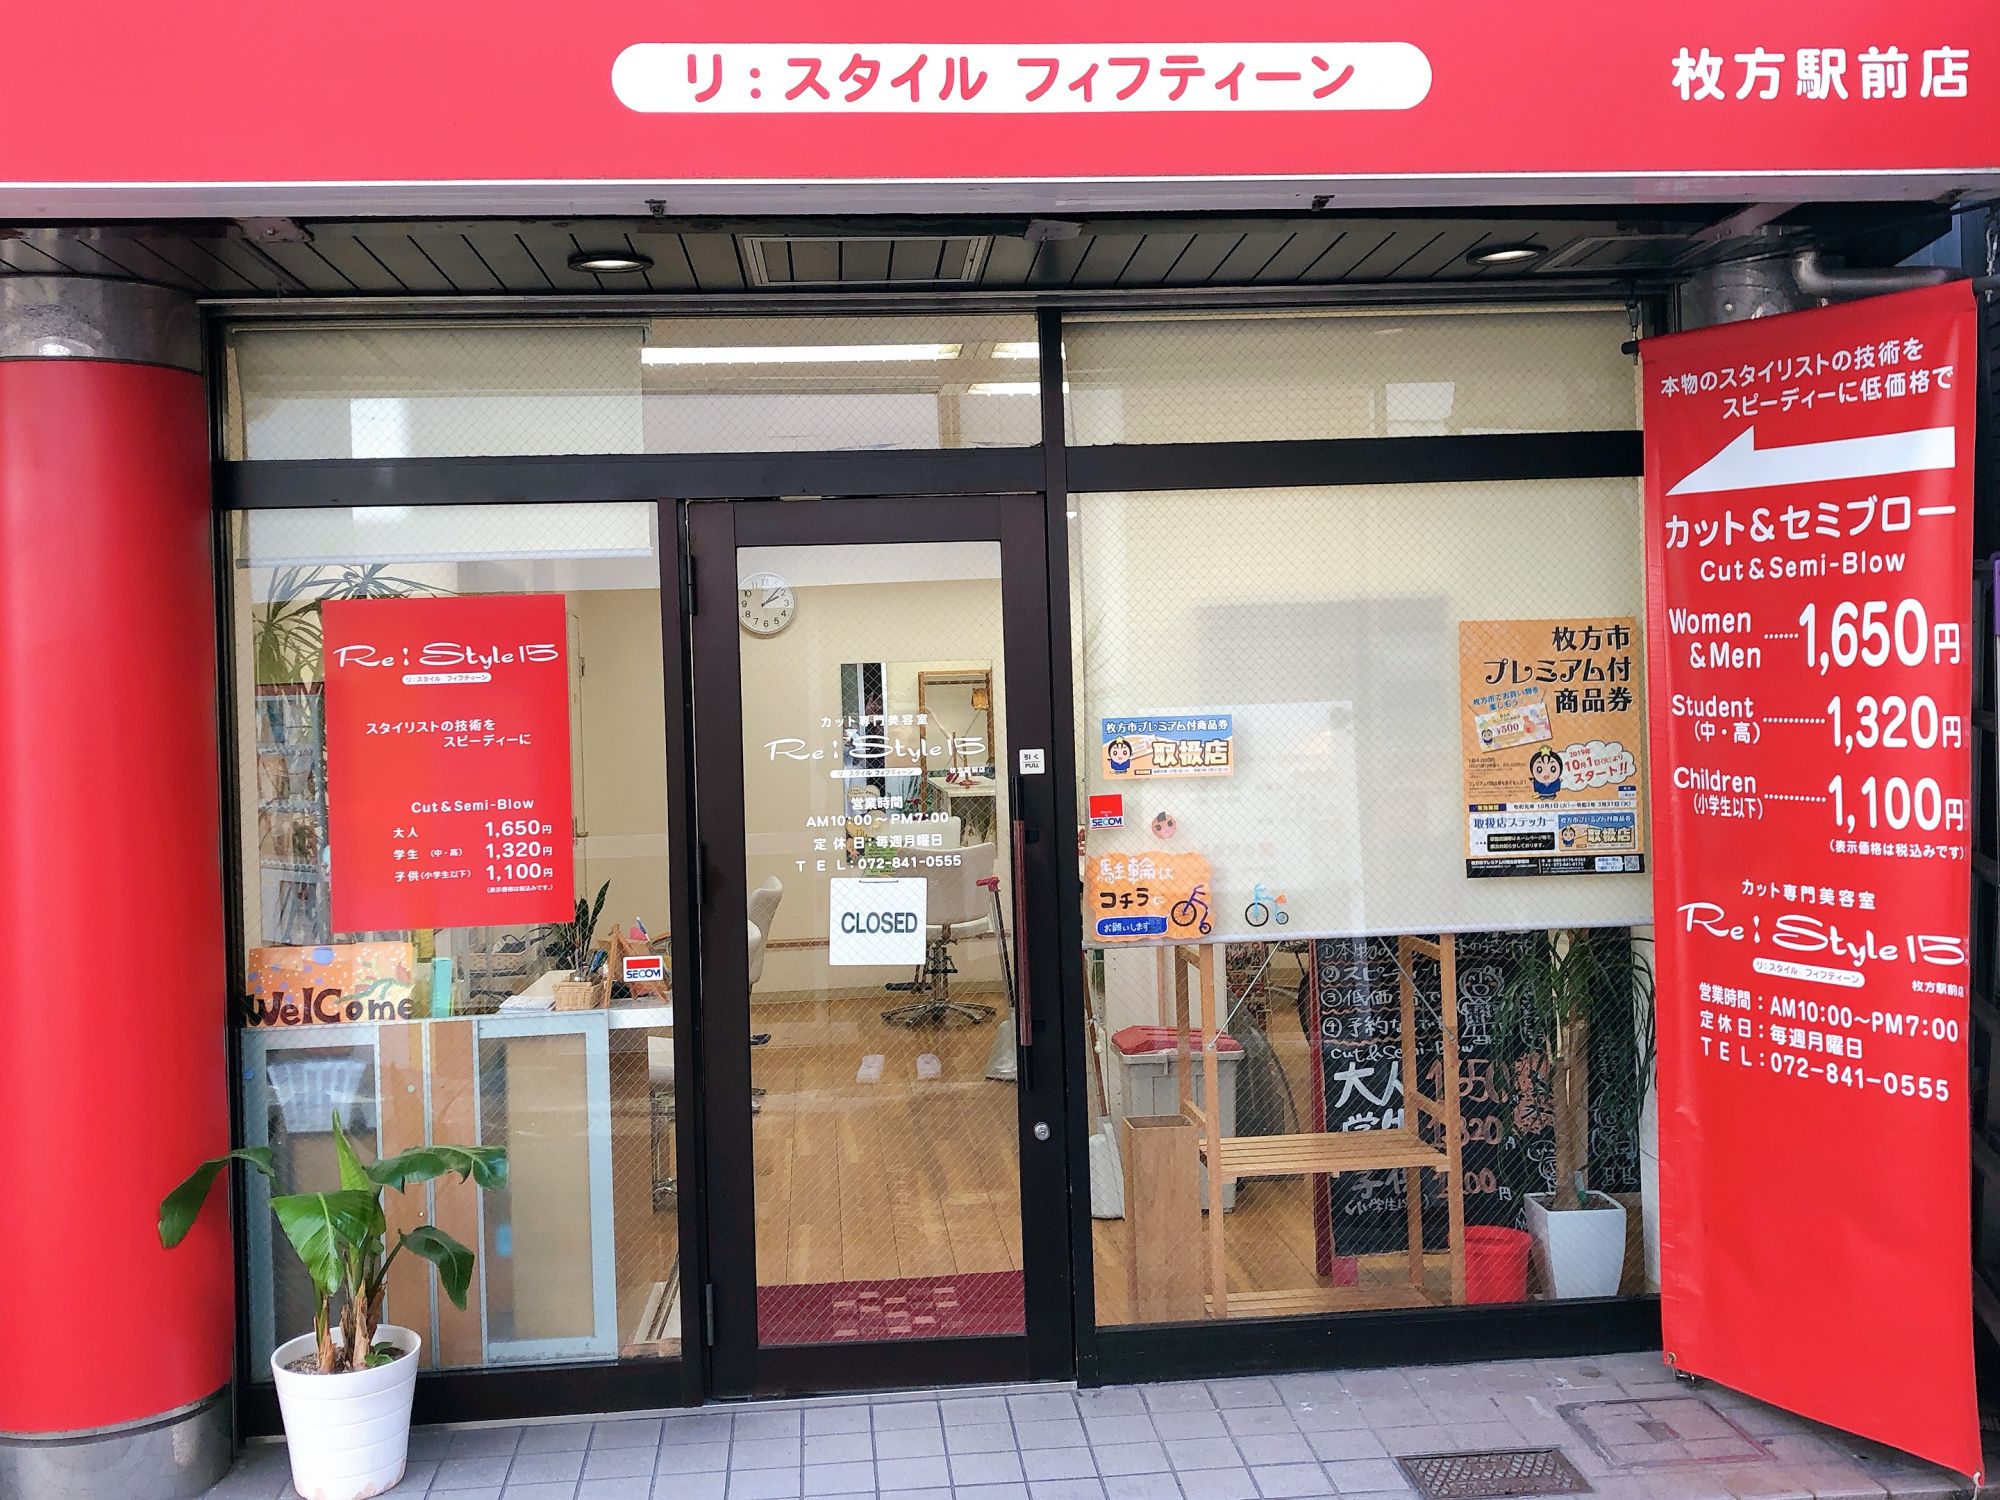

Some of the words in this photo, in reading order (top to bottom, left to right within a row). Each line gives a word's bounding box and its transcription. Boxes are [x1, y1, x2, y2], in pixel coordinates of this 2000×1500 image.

[1016, 56, 1355, 101] フィフティーン
[1672, 46, 1970, 102] 枚方駅前店
[1661, 337, 1924, 397] 本物のスタイリストの技術を
[1723, 366, 1954, 419] スピーディーに低価格で
[1665, 495, 1957, 549] カット&セミブロー
[742, 600, 747, 608] 9
[745, 610, 751, 618] 8
[753, 618, 759, 626] 7
[763, 620, 769, 628] 6
[774, 617, 780, 625] 5
[1668, 608, 1751, 635] Women
[1551, 624, 1631, 652] 枚方市
[1689, 642, 1761, 669] &Men
[1483, 656, 1633, 685] プレミアム付
[1554, 687, 1633, 713] 商品券
[1672, 694, 1754, 718] Student
[366, 718, 496, 736] スタイリストの技術を
[820, 714, 929, 728] カット専門美容室
[1106, 719, 1229, 734] 枚方市プレミアム付商品券
[443, 734, 532, 748] スピーディーに
[1152, 739, 1229, 768] 取扱店
[1673, 767, 1756, 793] Children
[851, 796, 903, 810] 営業時間
[392, 827, 419, 839] 大人
[1091, 817, 1122, 827] SECOM
[393, 849, 419, 860] 学生
[1097, 857, 1174, 884] 駐輪は
[1741, 879, 1876, 911] カット専門美容室
[841, 911, 918, 934] CLOSED
[1103, 922, 1150, 932] お願いします
[626, 968, 661, 979] SECOM
